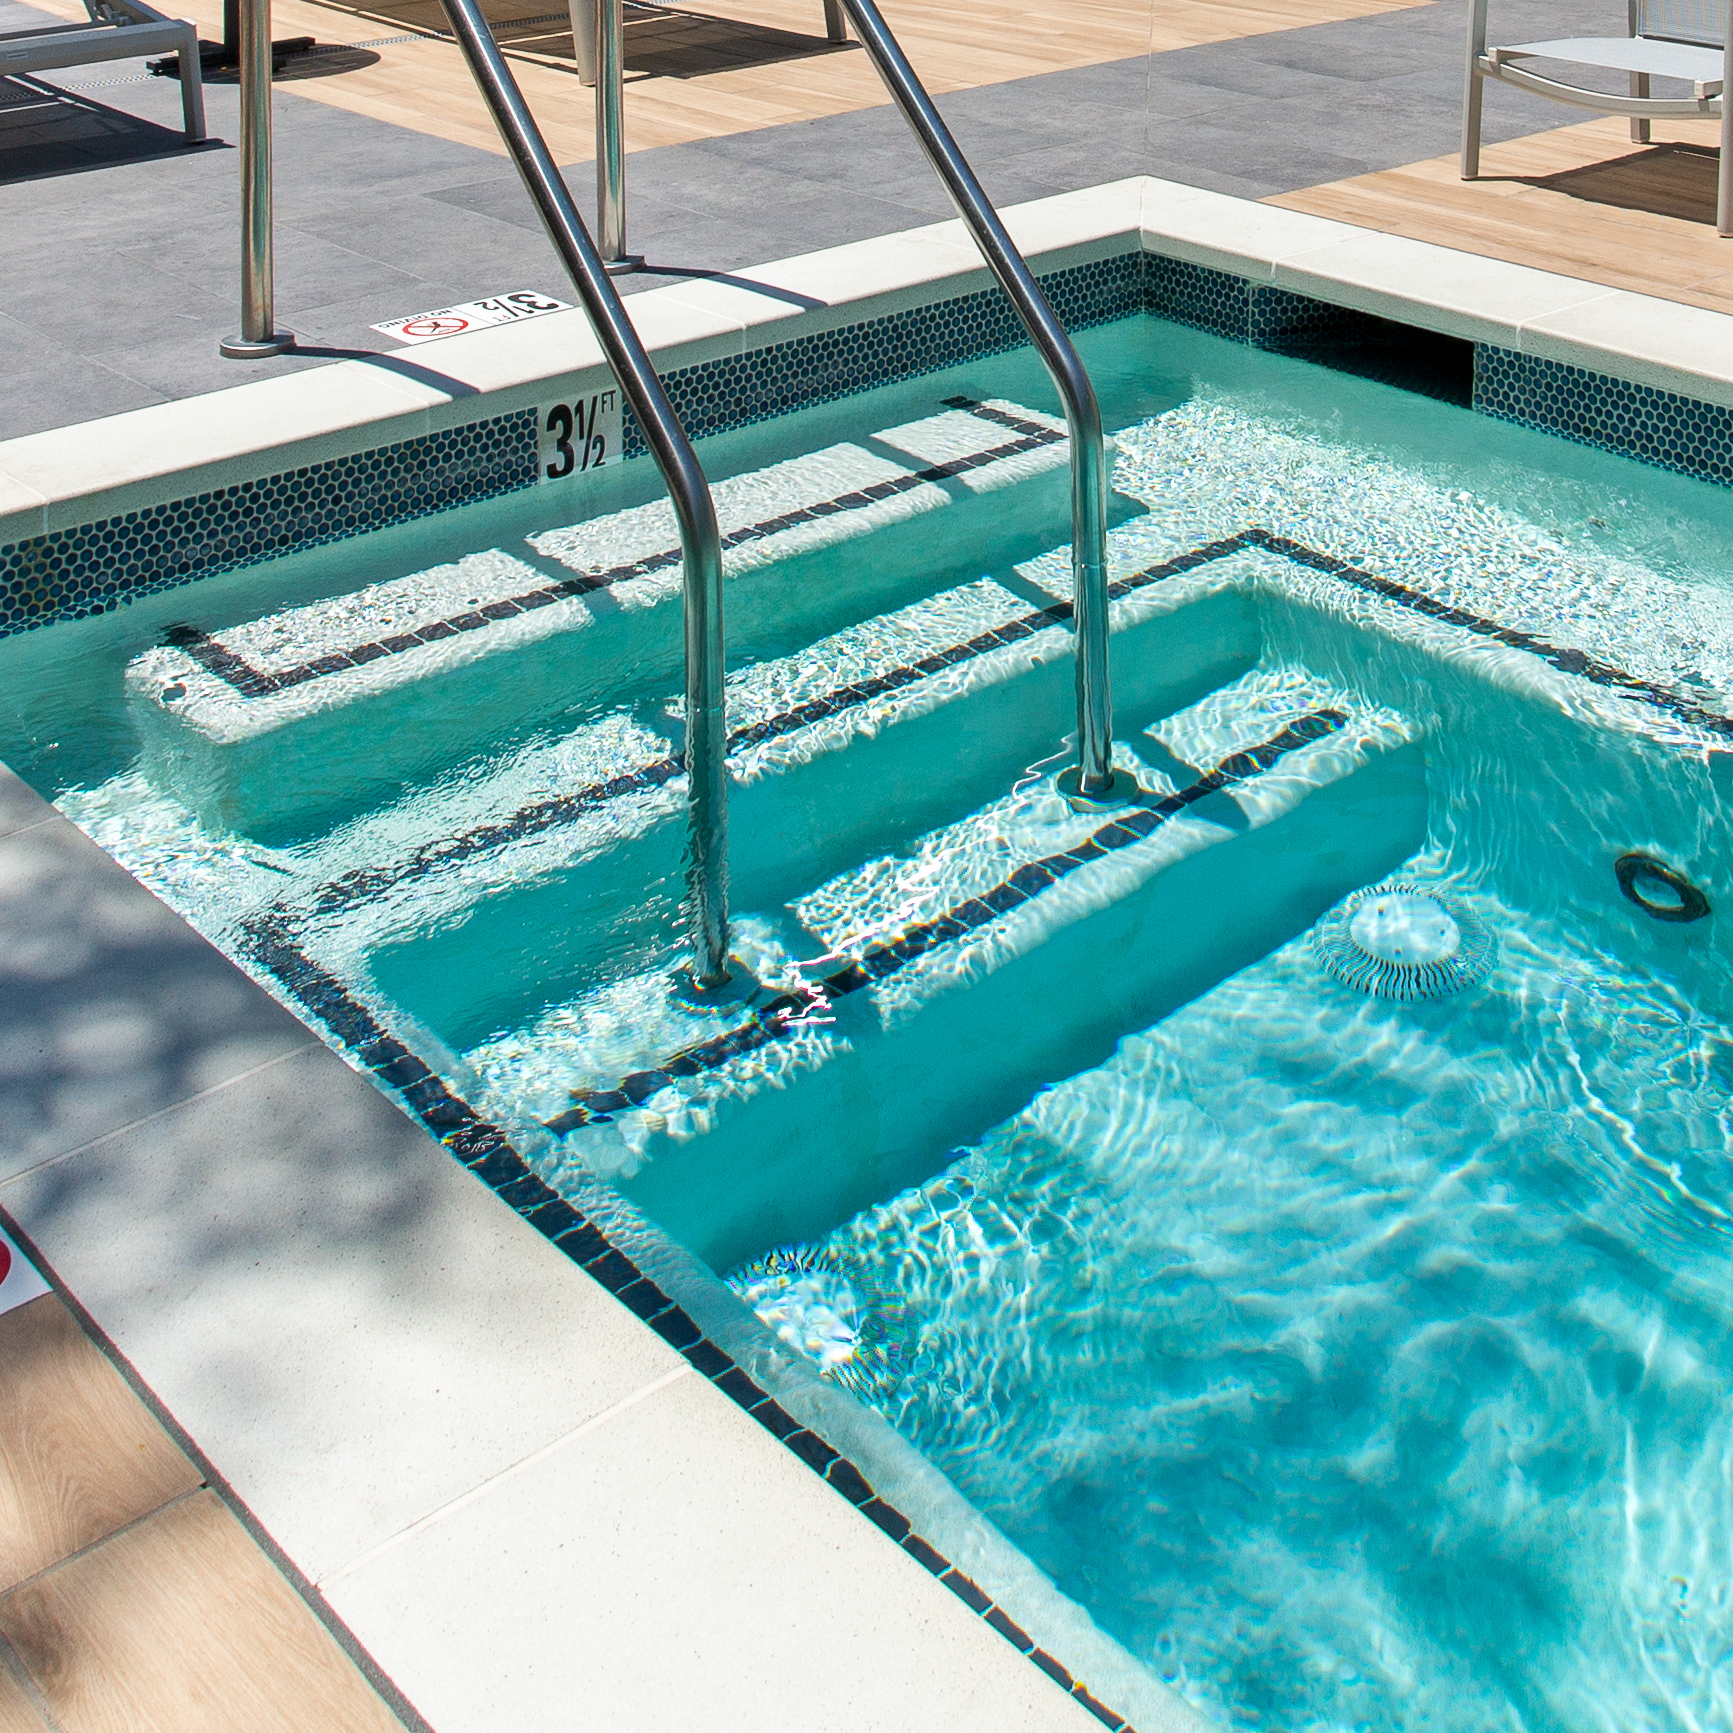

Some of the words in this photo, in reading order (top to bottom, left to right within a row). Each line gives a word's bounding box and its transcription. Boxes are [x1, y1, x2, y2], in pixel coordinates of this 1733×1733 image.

[431, 309, 453, 317] NO
[378, 314, 428, 329] DIVING
[600, 389, 617, 414] FT
